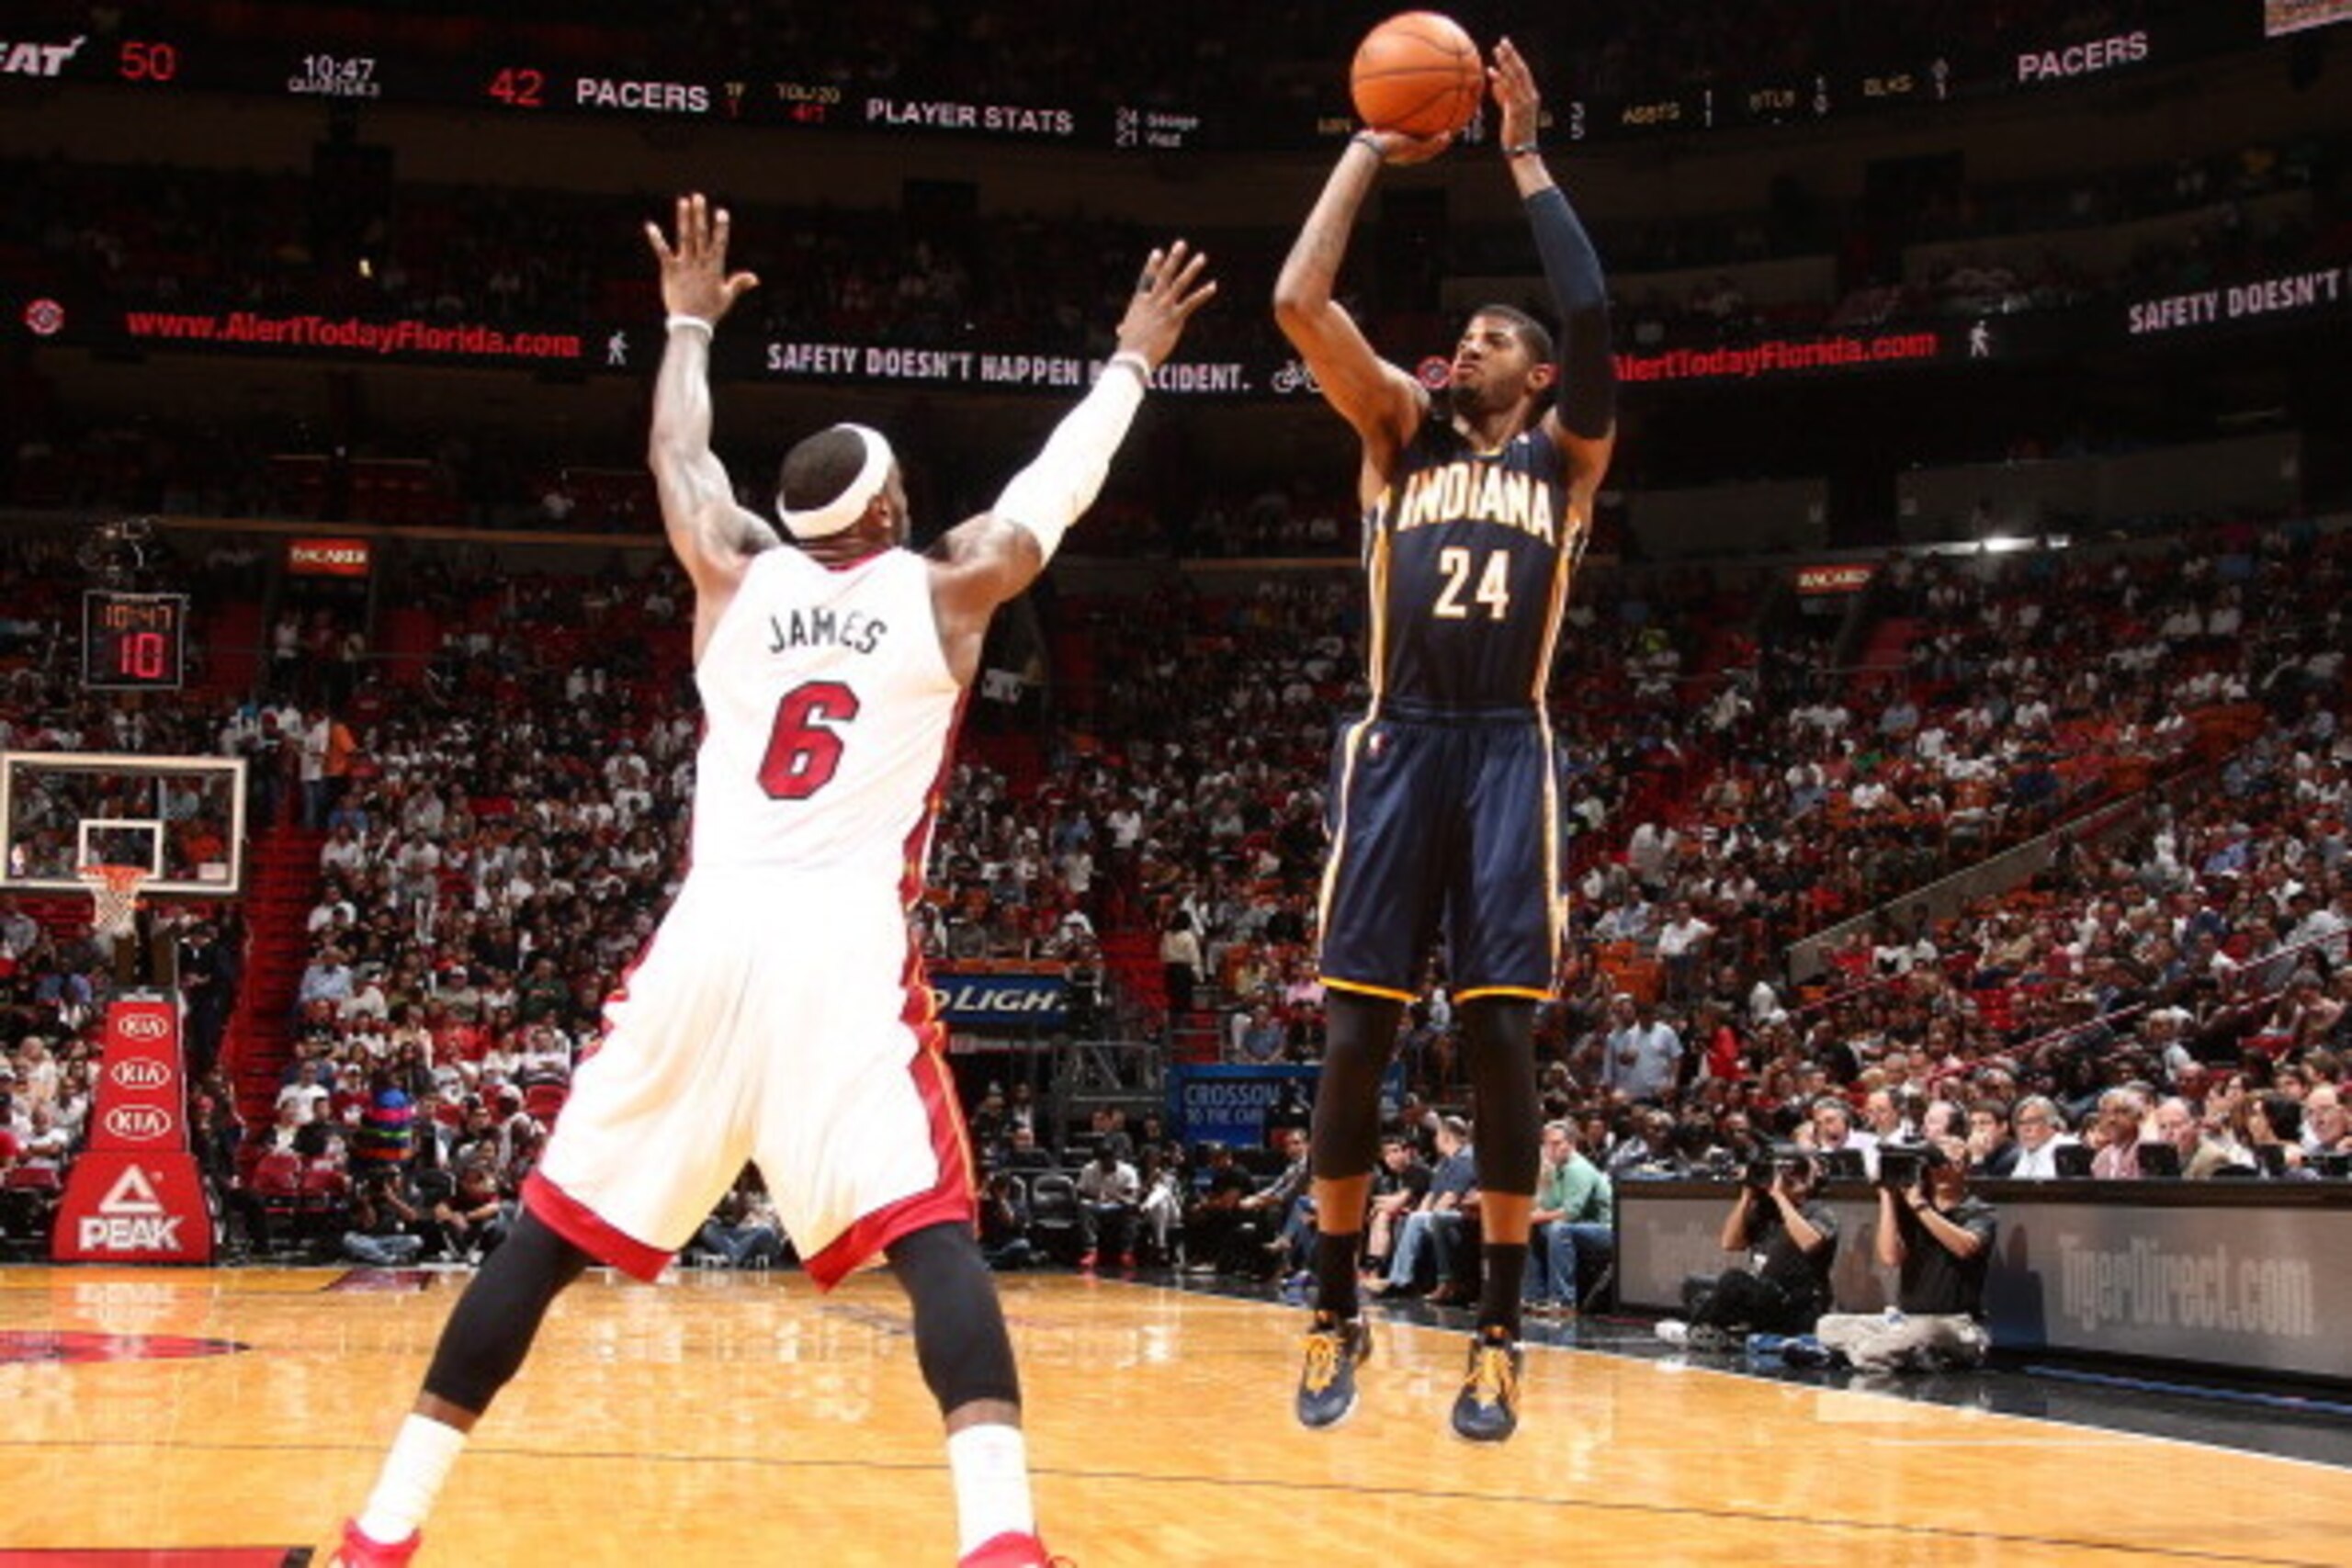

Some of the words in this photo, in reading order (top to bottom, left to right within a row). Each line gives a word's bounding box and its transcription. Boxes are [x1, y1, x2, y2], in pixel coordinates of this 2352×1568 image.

[0, 35, 85, 76] AT
[121, 42, 175, 81] 50
[303, 54, 376, 80] 10:47
[2018, 31, 2148, 82] PACERS
[490, 69, 542, 107] 42
[577, 79, 709, 112] PACERS
[865, 98, 978, 128] PLAYER
[983, 106, 1074, 135] STATS
[2129, 289, 2219, 334] SAFETY
[2228, 268, 2342, 318] DOESN'T
[126, 311, 582, 357] www.AlertTodayFlorida.com
[766, 343, 860, 374] SAFETY
[865, 349, 974, 381] DOESN'T
[980, 355, 1080, 386] HAPPEN
[1144, 362, 1253, 392] CCIDENT.
[1396, 459, 1556, 547] INDIANA
[1433, 546, 1510, 620] 24
[767, 605, 888, 655] JAMES
[121, 632, 164, 679] 10
[756, 679, 861, 800] 6
[952, 984, 1068, 1012] LIGH
[125, 1019, 159, 1035] KIA
[120, 1065, 161, 1083] KIA
[116, 1111, 161, 1132] KIA
[78, 1216, 187, 1252] PEAK
[2057, 1234, 2314, 1337] TigerDirect.com
